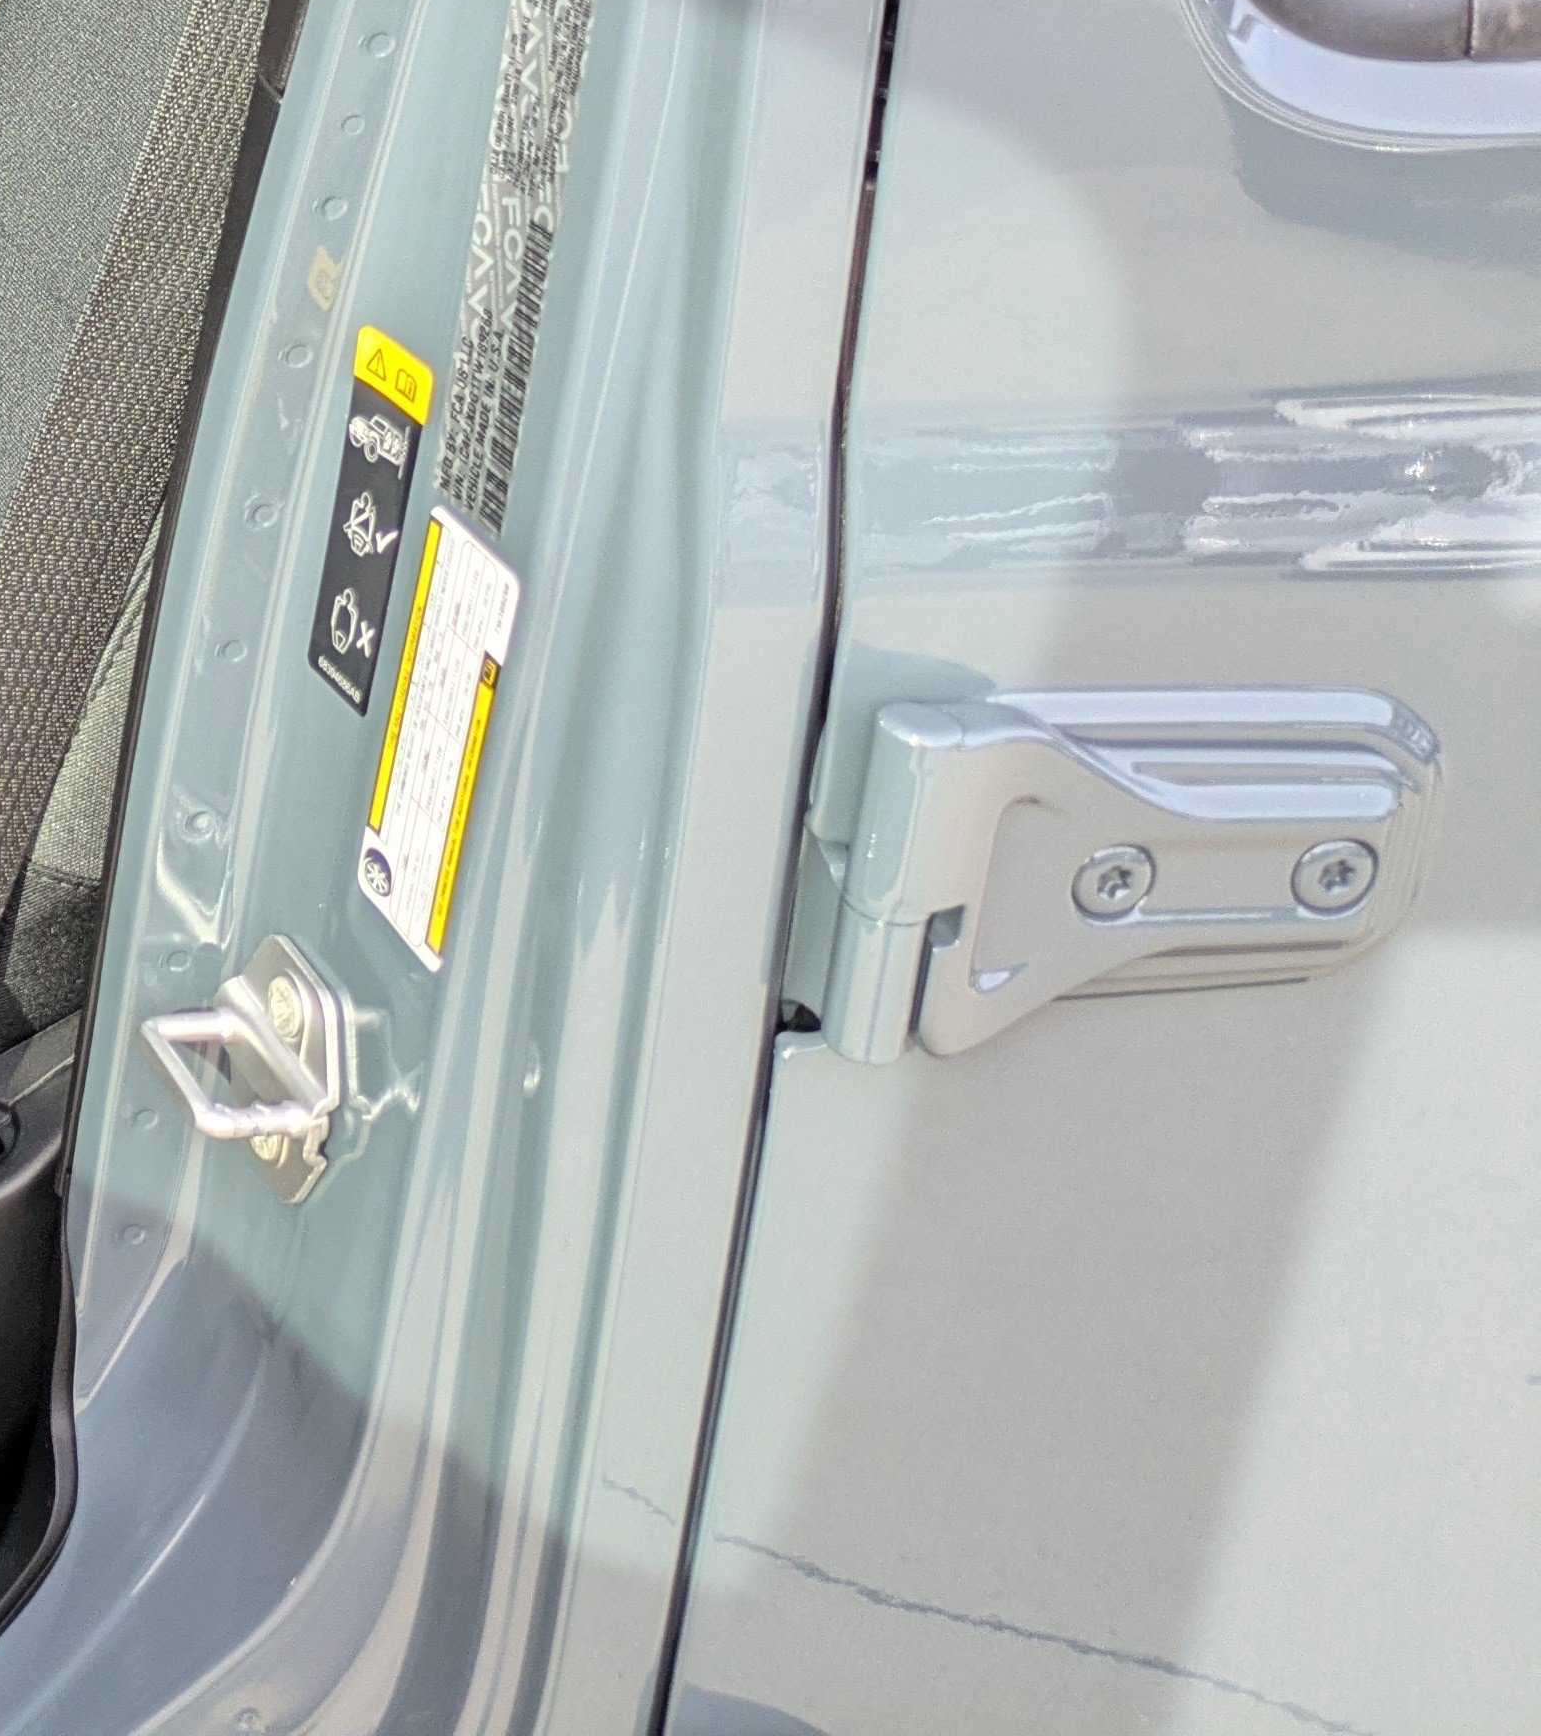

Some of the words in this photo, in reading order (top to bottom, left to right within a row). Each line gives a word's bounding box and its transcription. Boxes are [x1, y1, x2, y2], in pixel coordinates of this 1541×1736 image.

[439, 455, 453, 492] MFD
[451, 391, 464, 424] FCA
[459, 334, 473, 366] LLC
[464, 447, 483, 512] VEHICLE
[475, 401, 490, 448] MADE
[404, 601, 422, 667] INFORMATION
